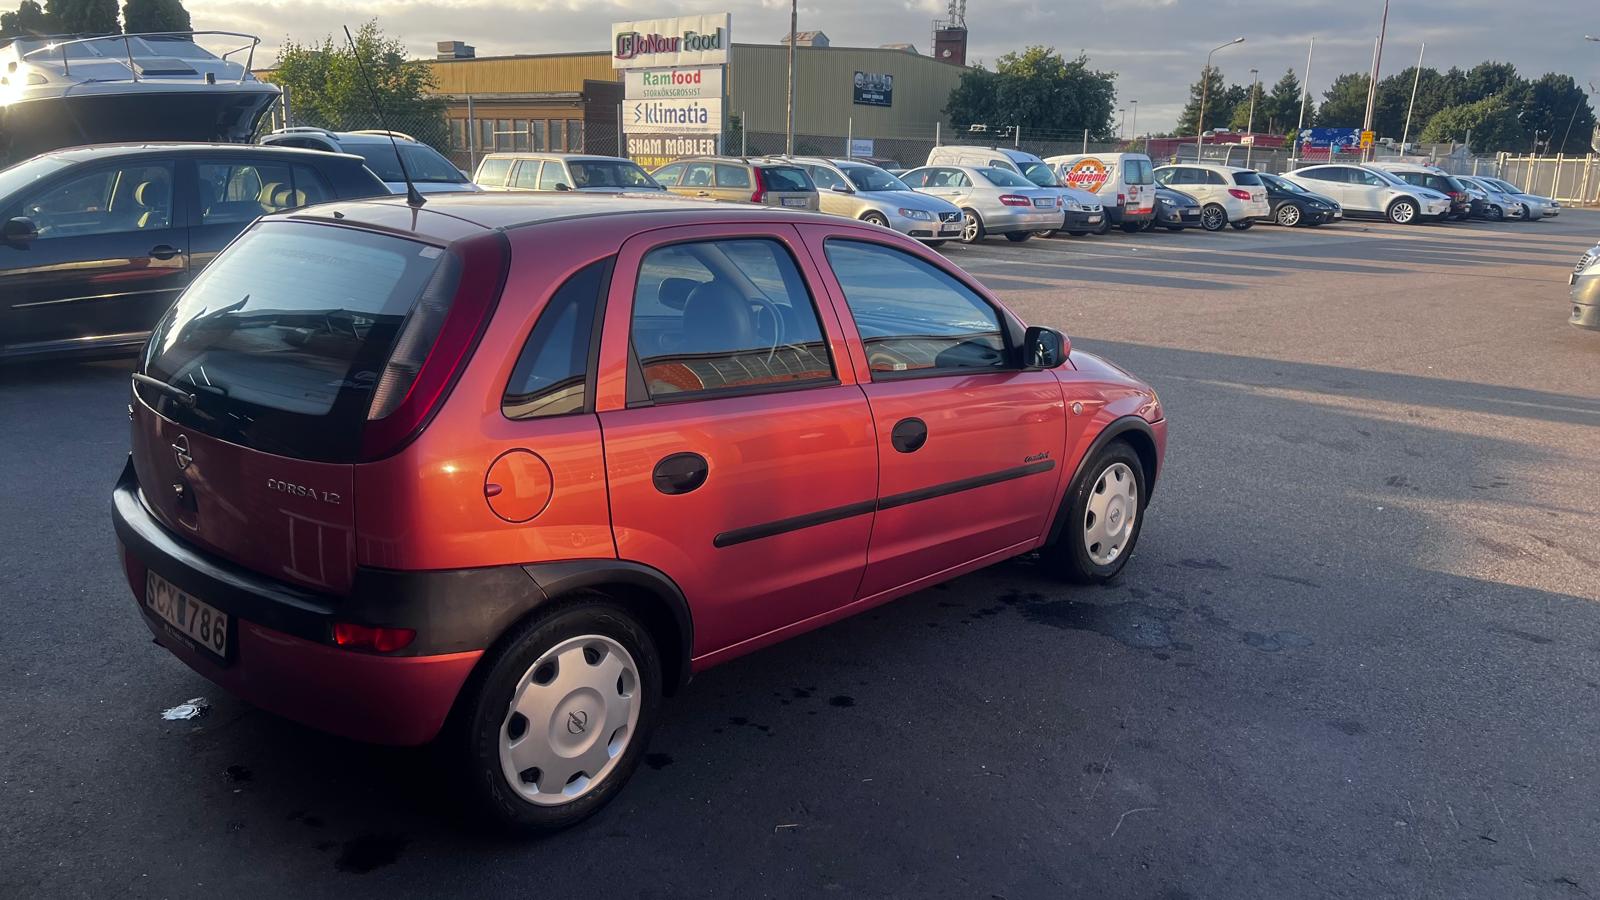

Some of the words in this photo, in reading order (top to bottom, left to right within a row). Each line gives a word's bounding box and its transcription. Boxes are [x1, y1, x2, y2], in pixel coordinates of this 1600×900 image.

[684, 27, 722, 51] Food
[643, 69, 701, 86] Ramfood
[645, 102, 708, 124] klimatia
[628, 139, 661, 155] SHAM
[665, 136, 715, 155] MÖBLER
[1066, 172, 1108, 183] Supreme
[267, 478, 318, 501] CORSA
[148, 573, 177, 625] SCX
[188, 599, 225, 651] 786
